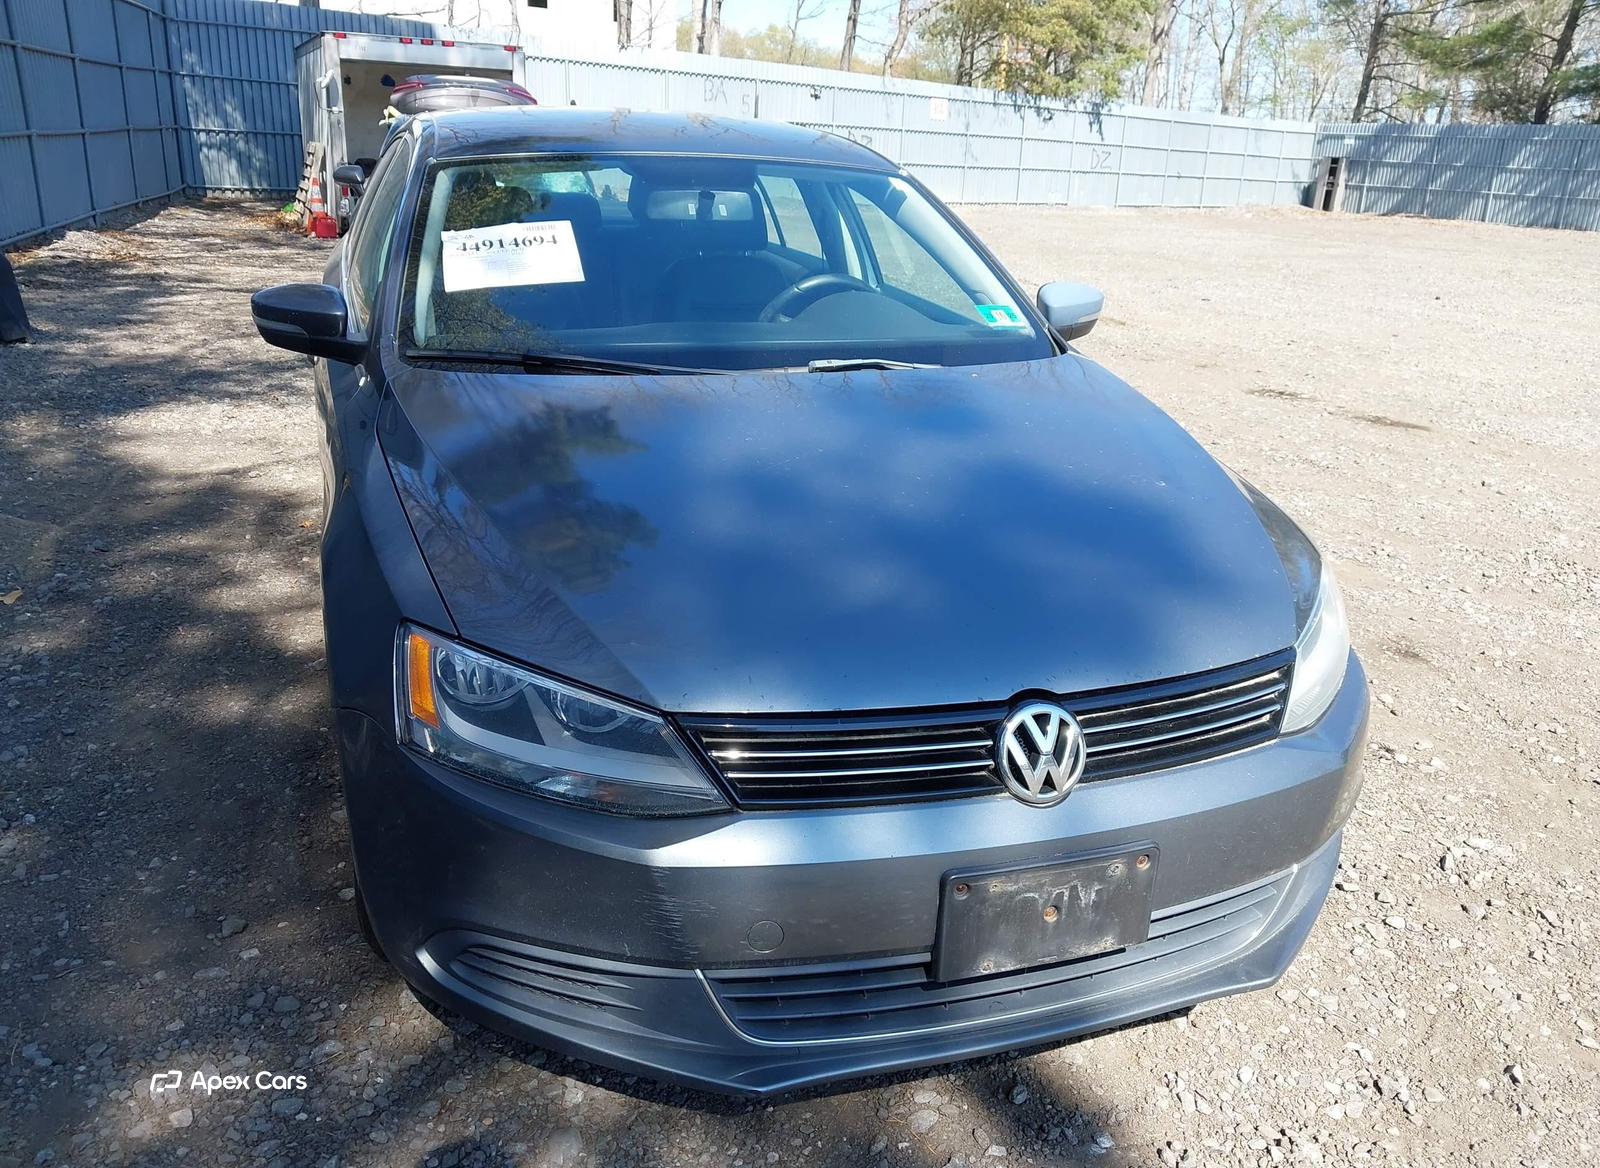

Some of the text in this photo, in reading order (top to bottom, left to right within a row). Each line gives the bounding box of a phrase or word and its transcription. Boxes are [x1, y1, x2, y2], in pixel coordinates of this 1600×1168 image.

[703, 79, 728, 104] BA
[456, 234, 558, 252] 44914694
[999, 702, 1084, 803] VW
